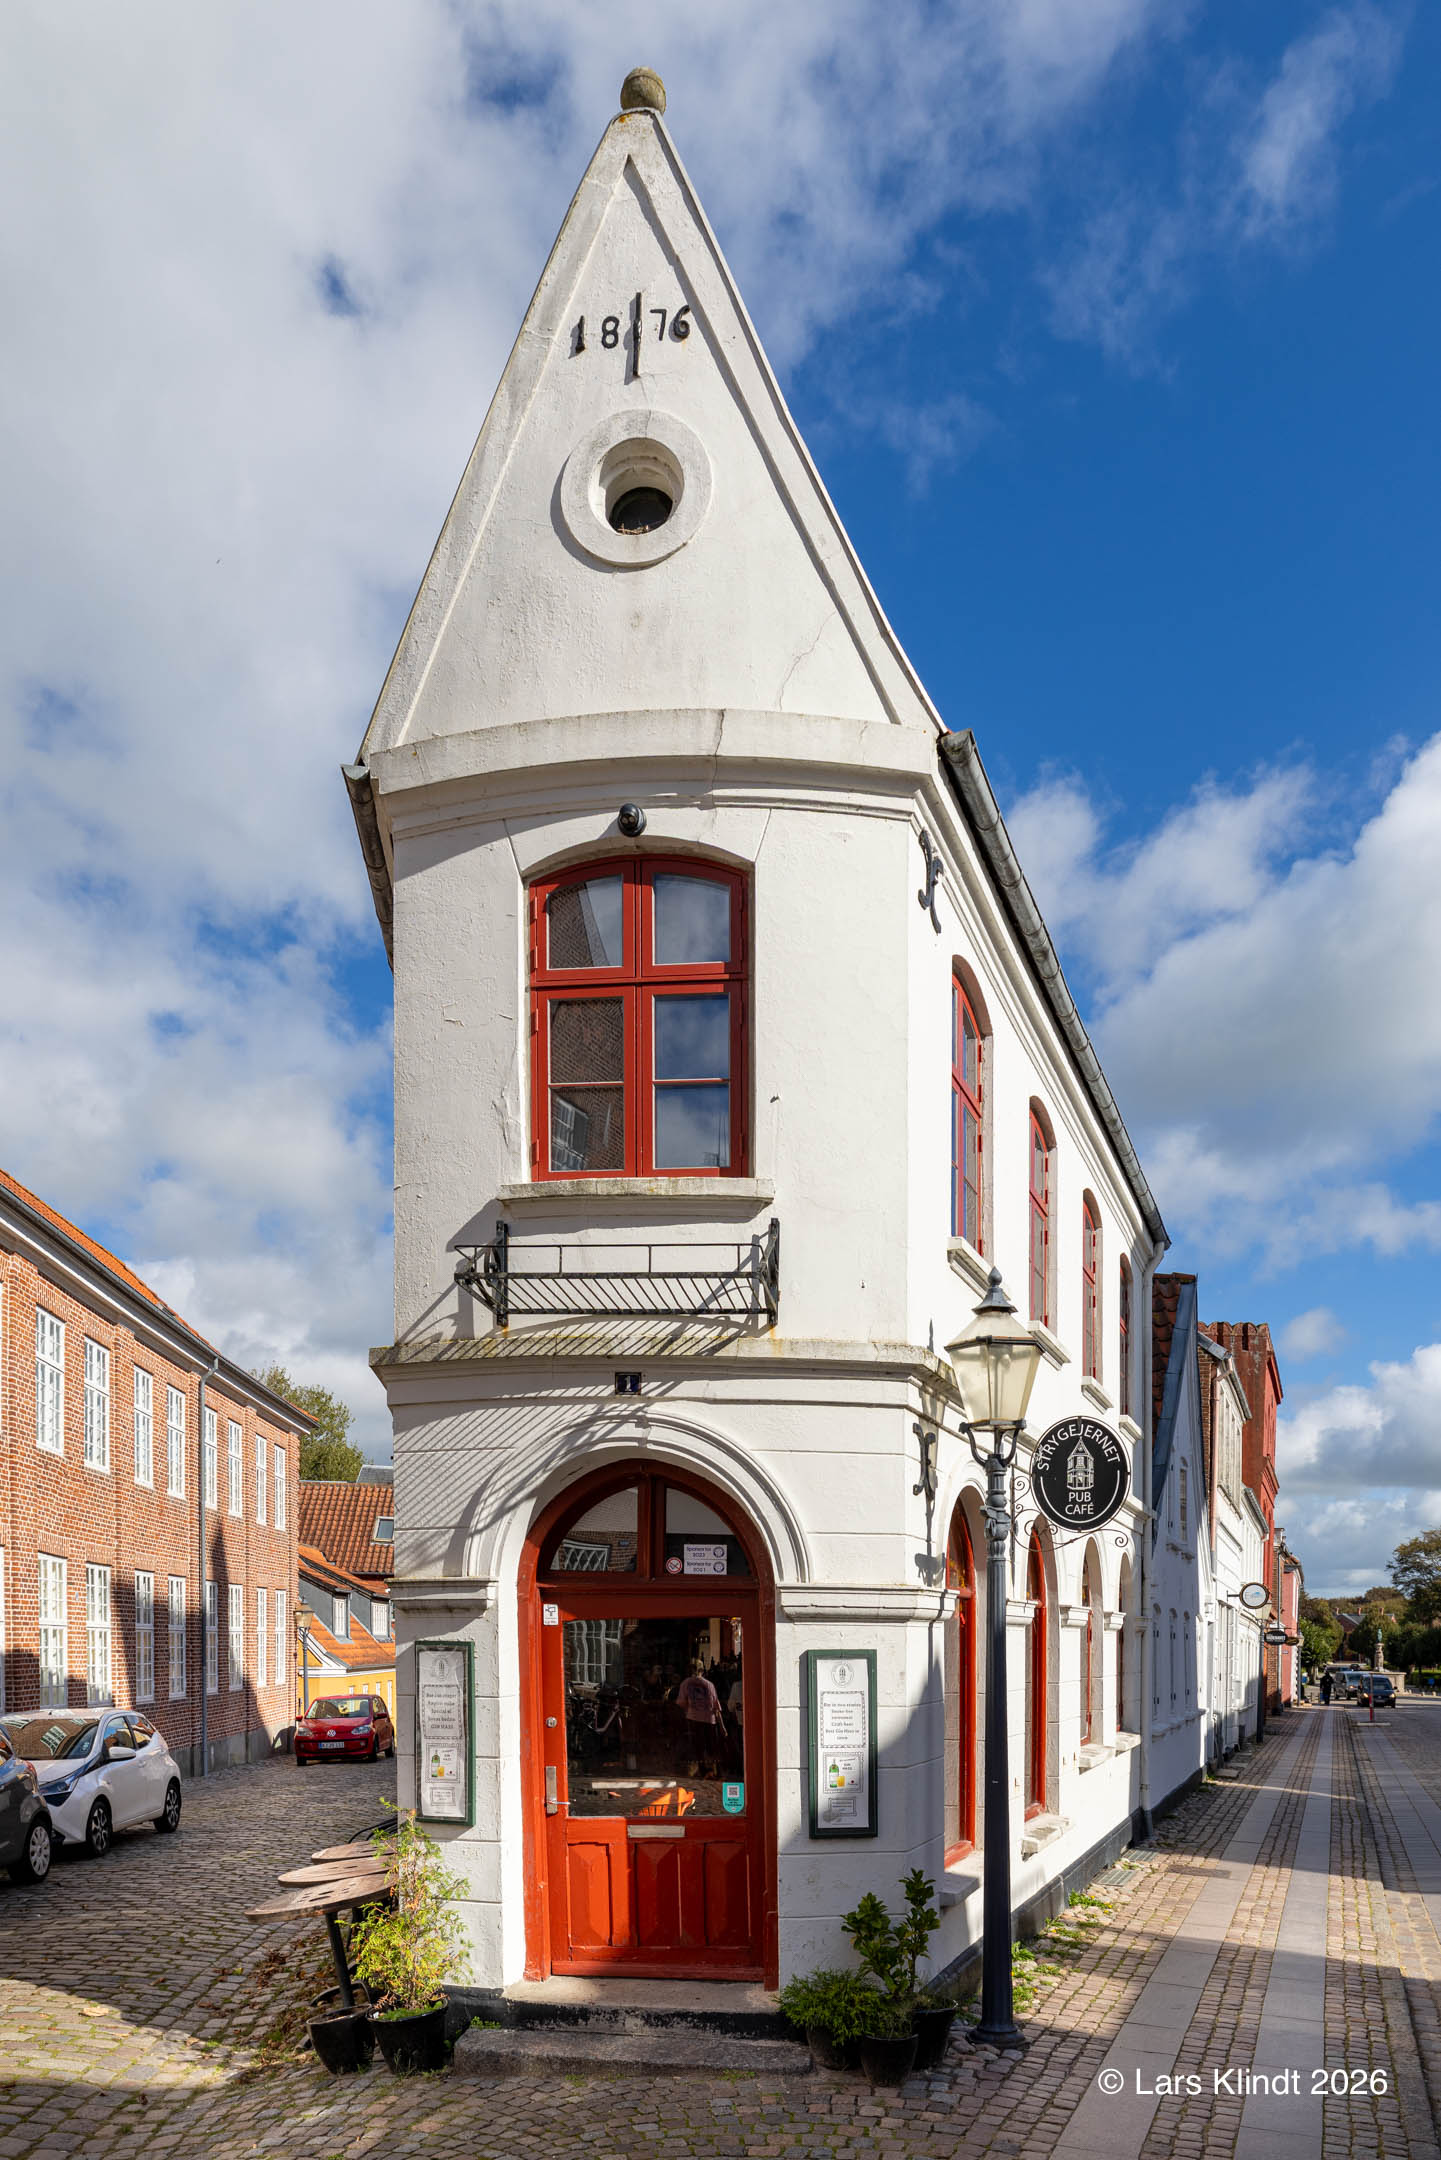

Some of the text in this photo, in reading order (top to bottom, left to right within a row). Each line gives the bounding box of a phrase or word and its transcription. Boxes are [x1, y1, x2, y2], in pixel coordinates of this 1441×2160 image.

[624, 1375, 632, 1392] 1
[1037, 1423, 1121, 1471] STRYGEJERNET
[1068, 1491, 1092, 1502] PUB
[1065, 1502, 1095, 1515] CAFÉ
